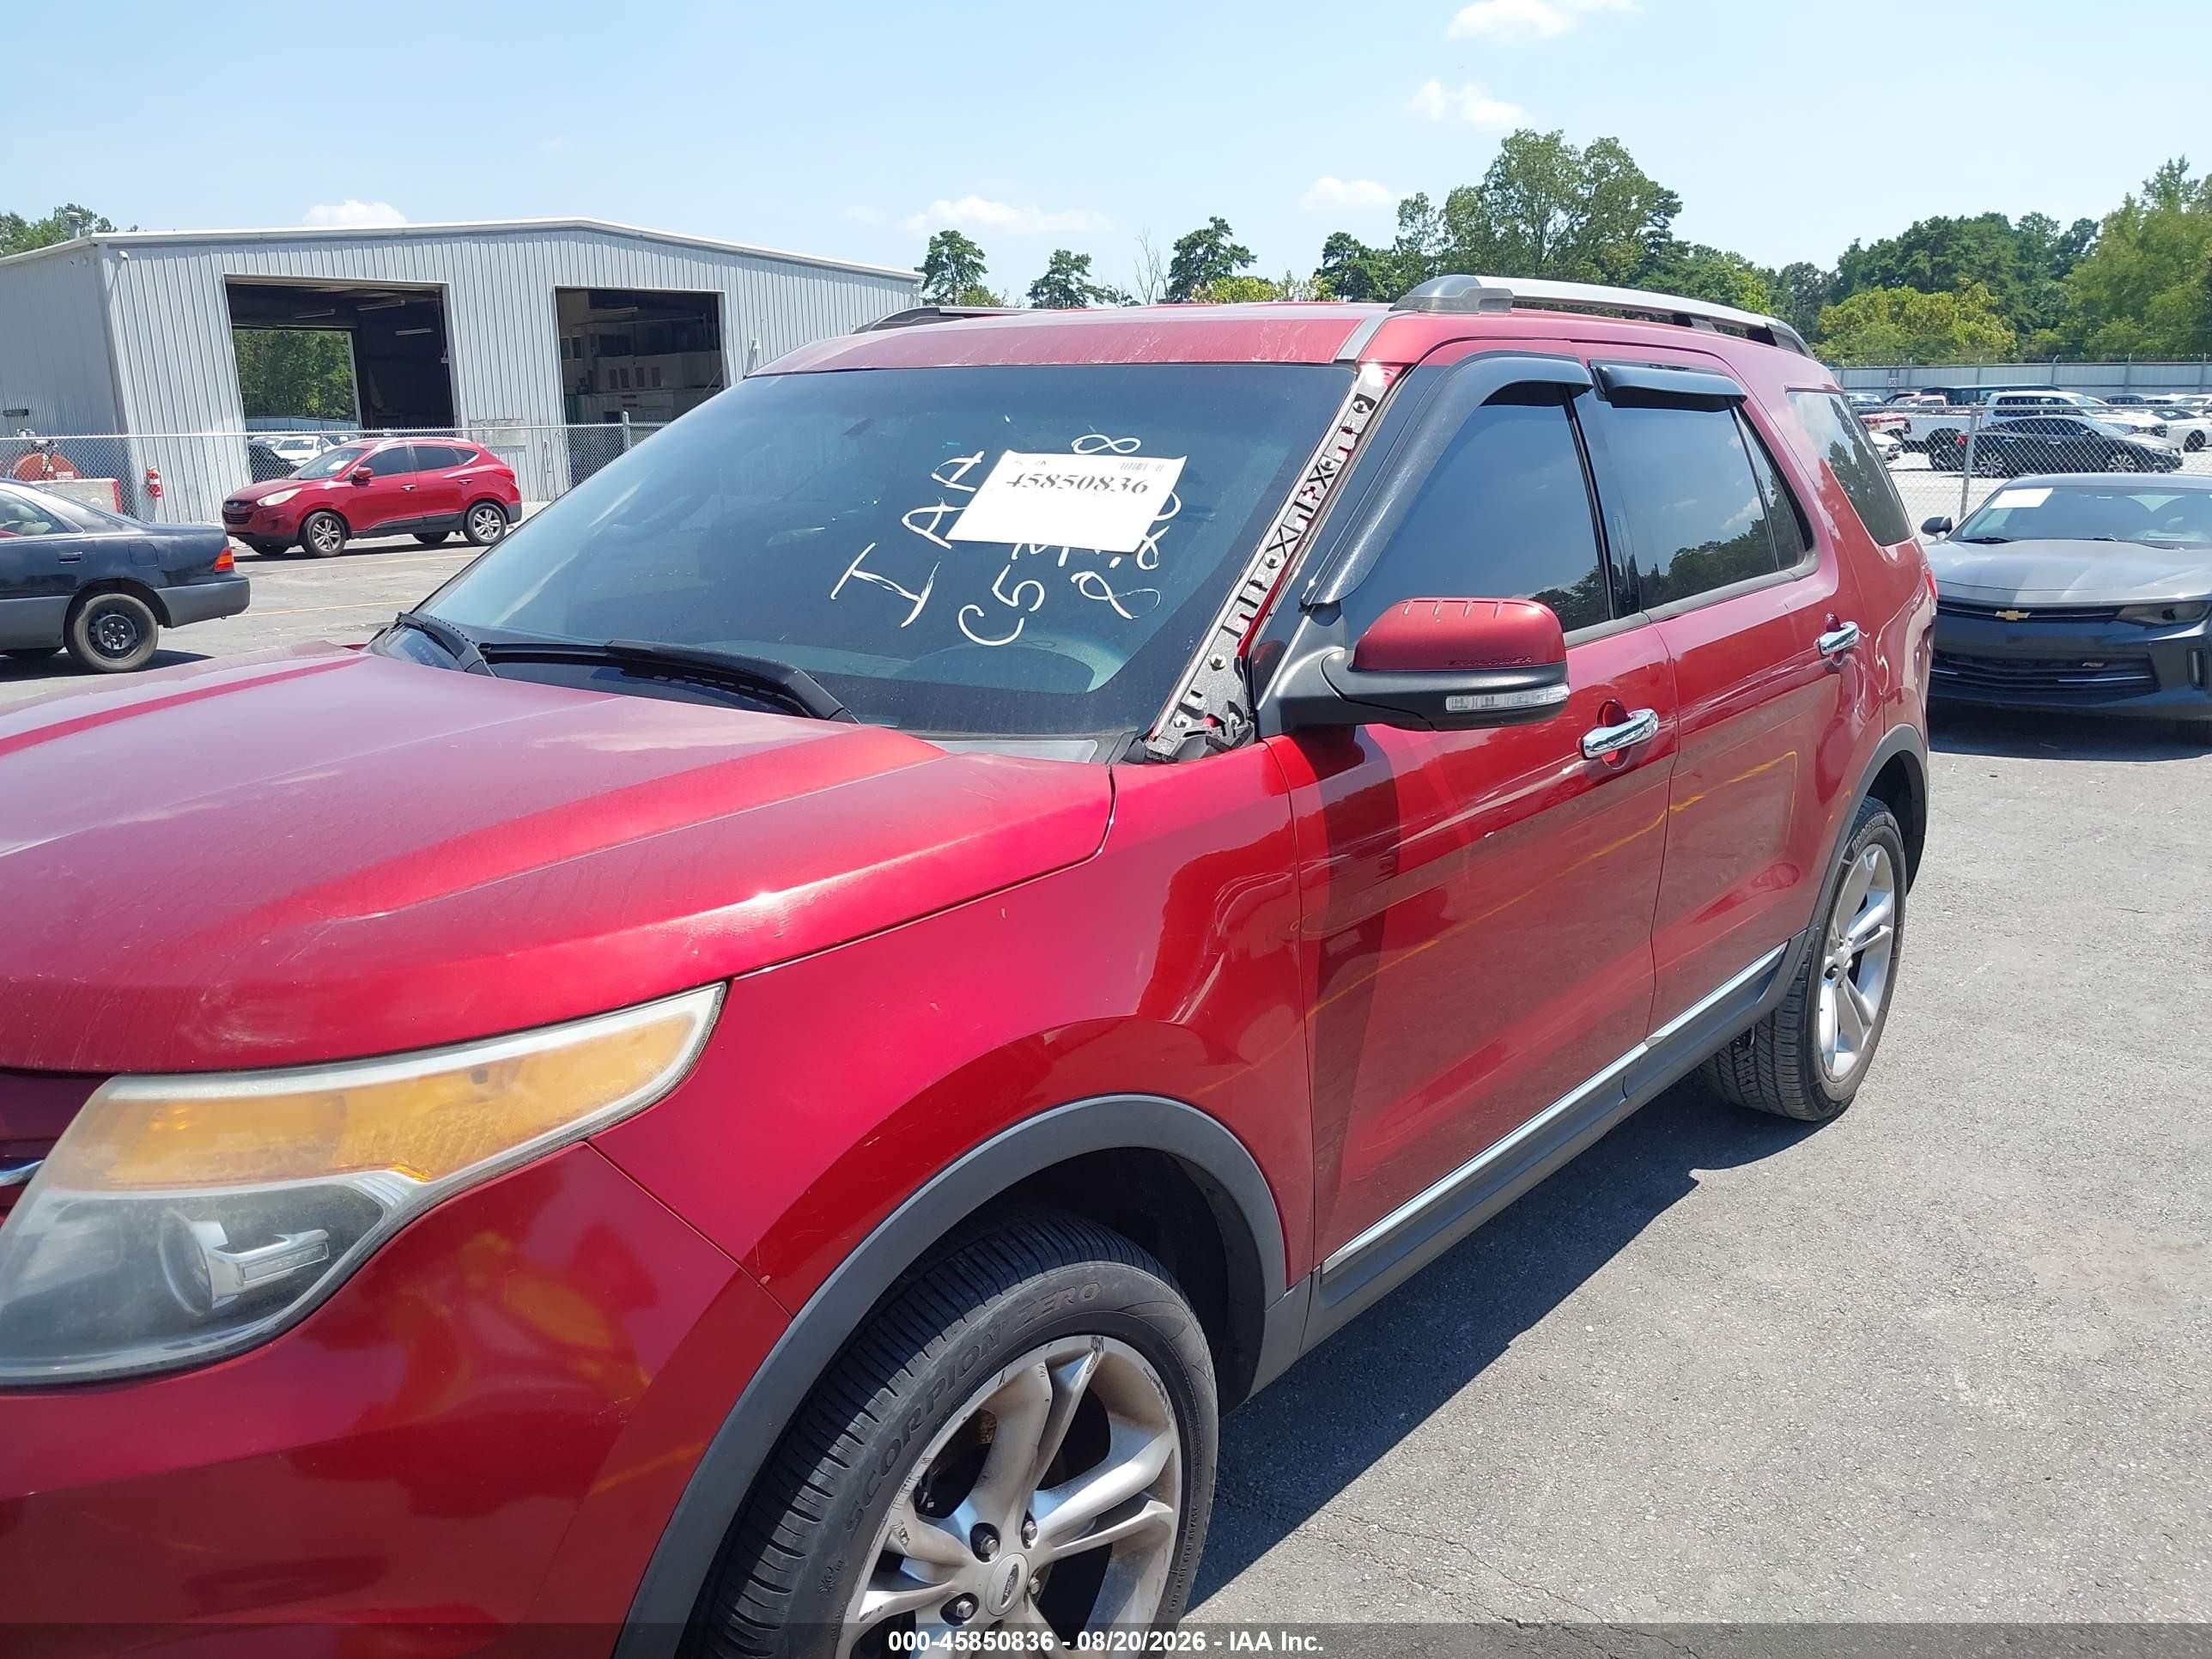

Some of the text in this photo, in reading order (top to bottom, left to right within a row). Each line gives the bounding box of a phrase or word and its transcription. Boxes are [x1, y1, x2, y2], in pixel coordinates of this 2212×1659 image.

[1006, 473, 1149, 494] 45850836
[845, 1282, 1101, 1534] SCORPION ZERO
